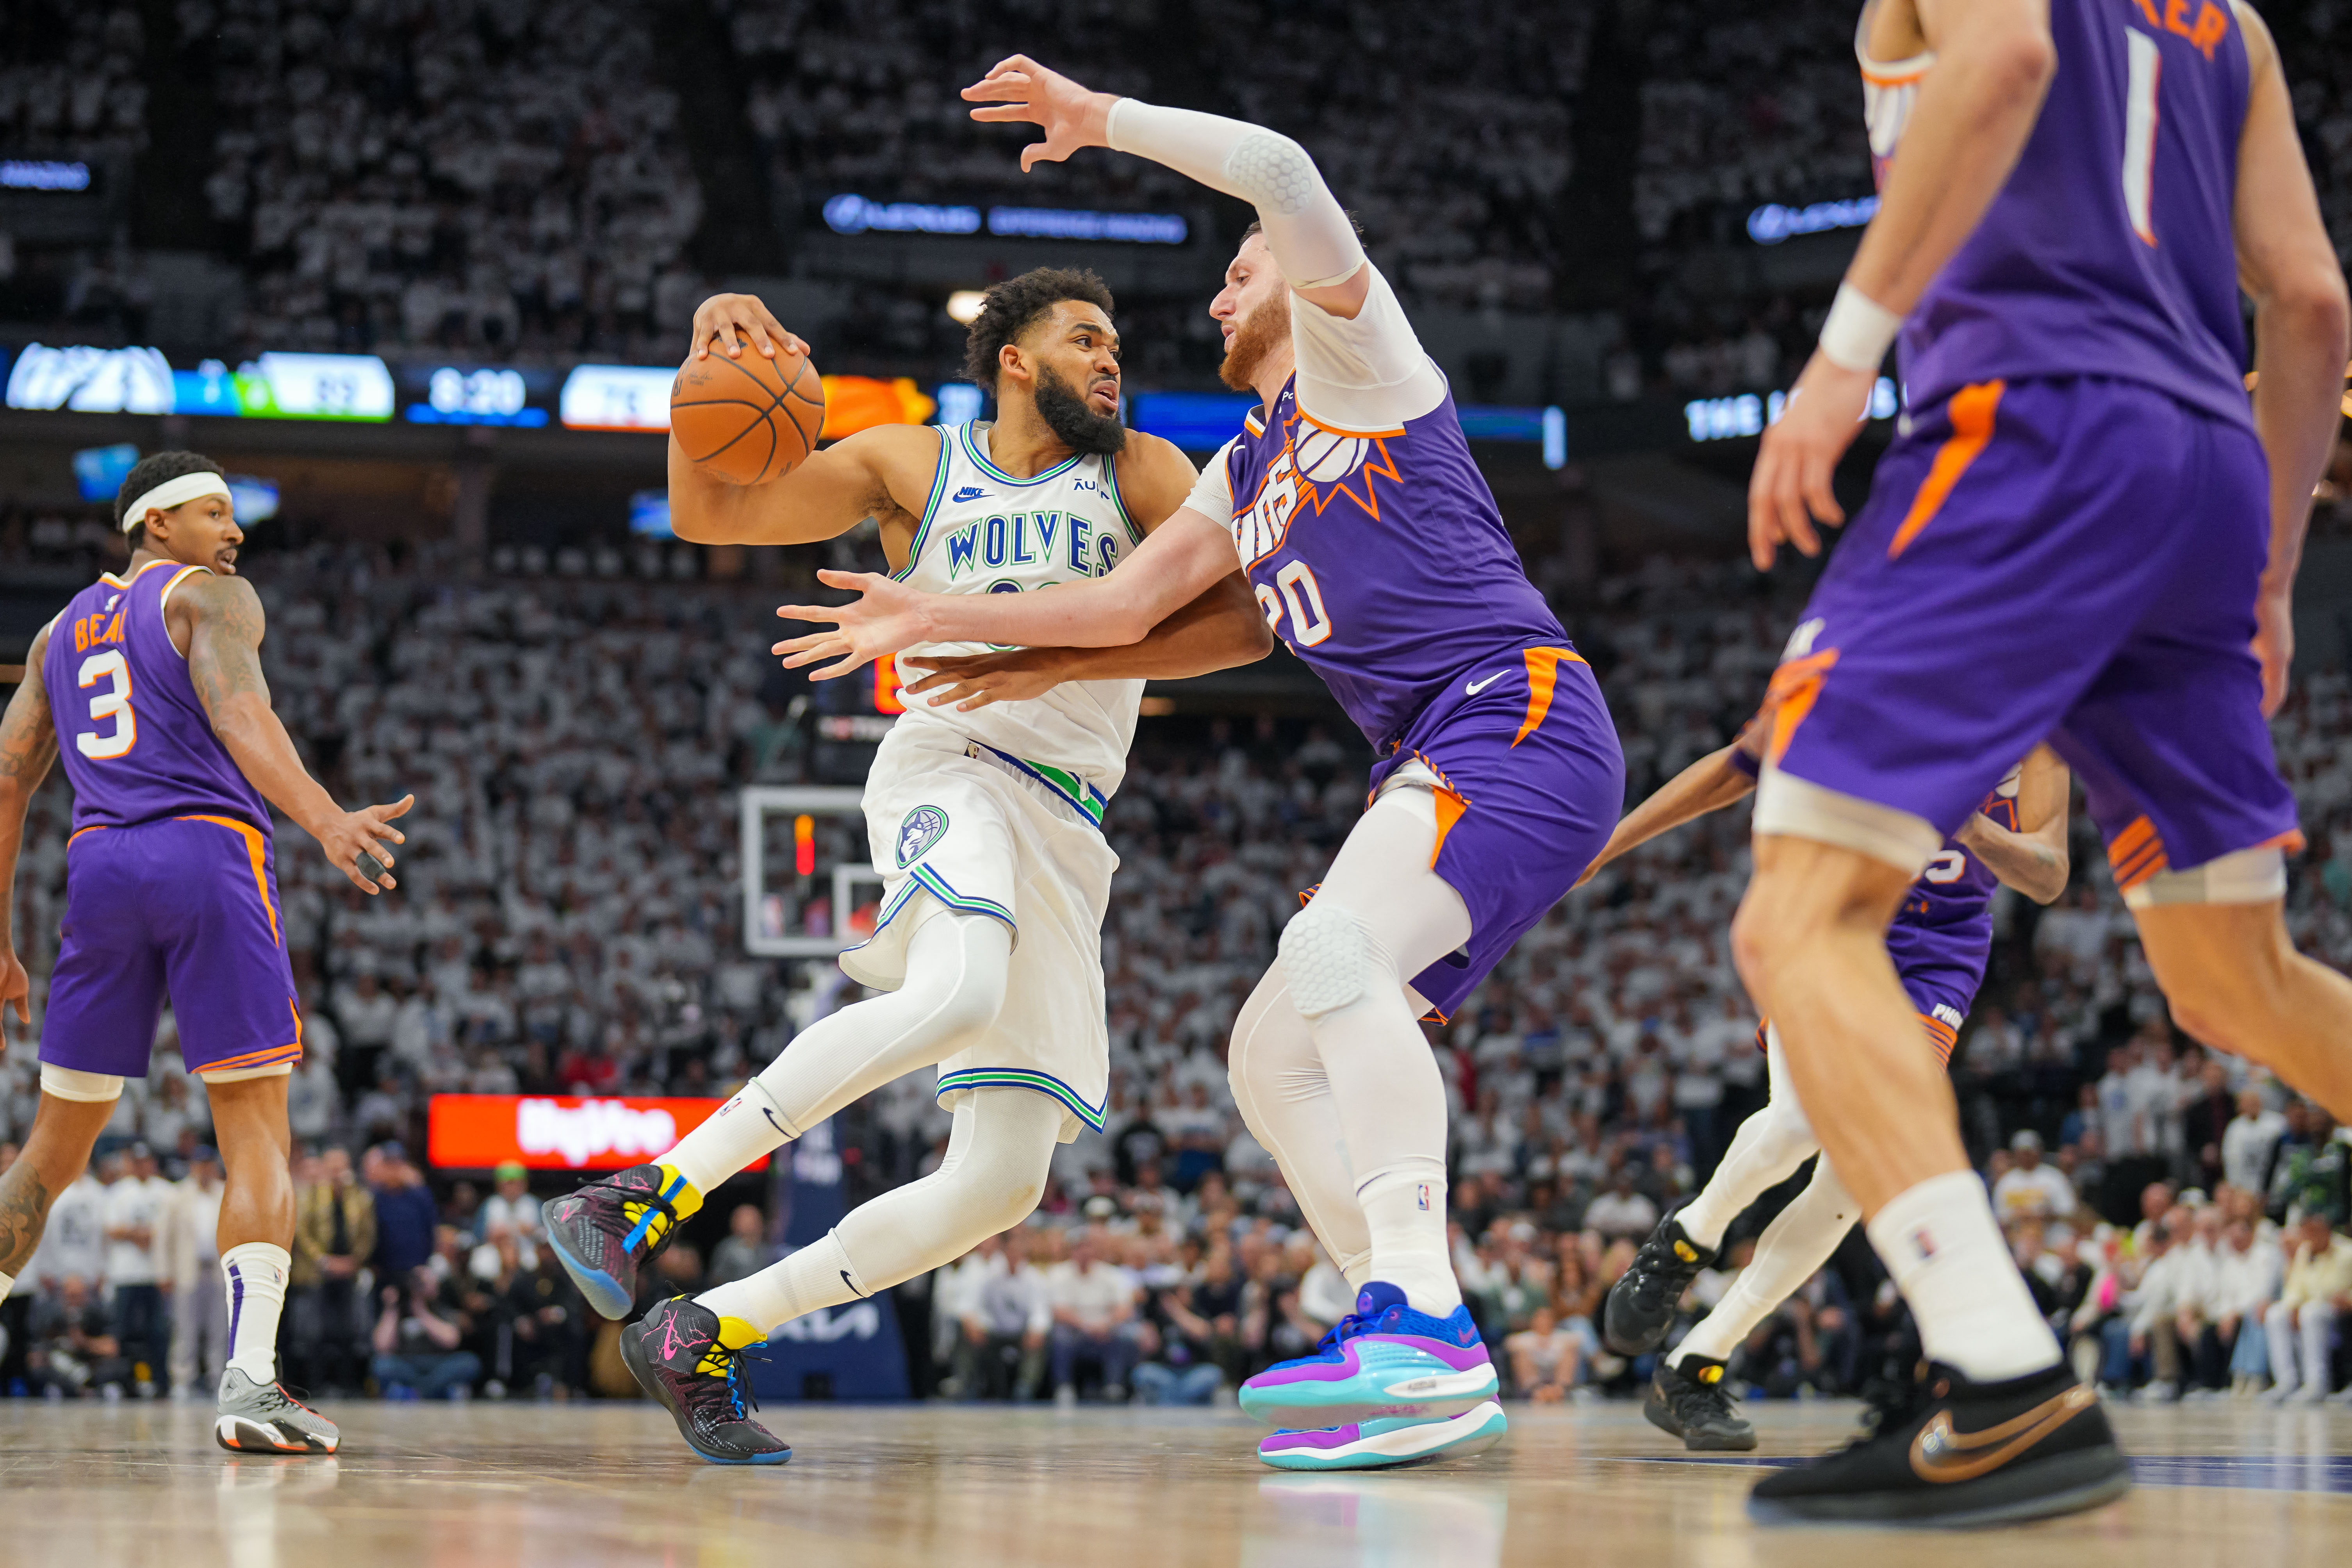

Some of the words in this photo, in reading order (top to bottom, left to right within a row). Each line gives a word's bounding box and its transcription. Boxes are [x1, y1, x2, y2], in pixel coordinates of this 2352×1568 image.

[2122, 24, 2163, 249] 1
[959, 487, 984, 496] NIKE
[945, 510, 1118, 582] WOLVES
[77, 648, 137, 760] 3
